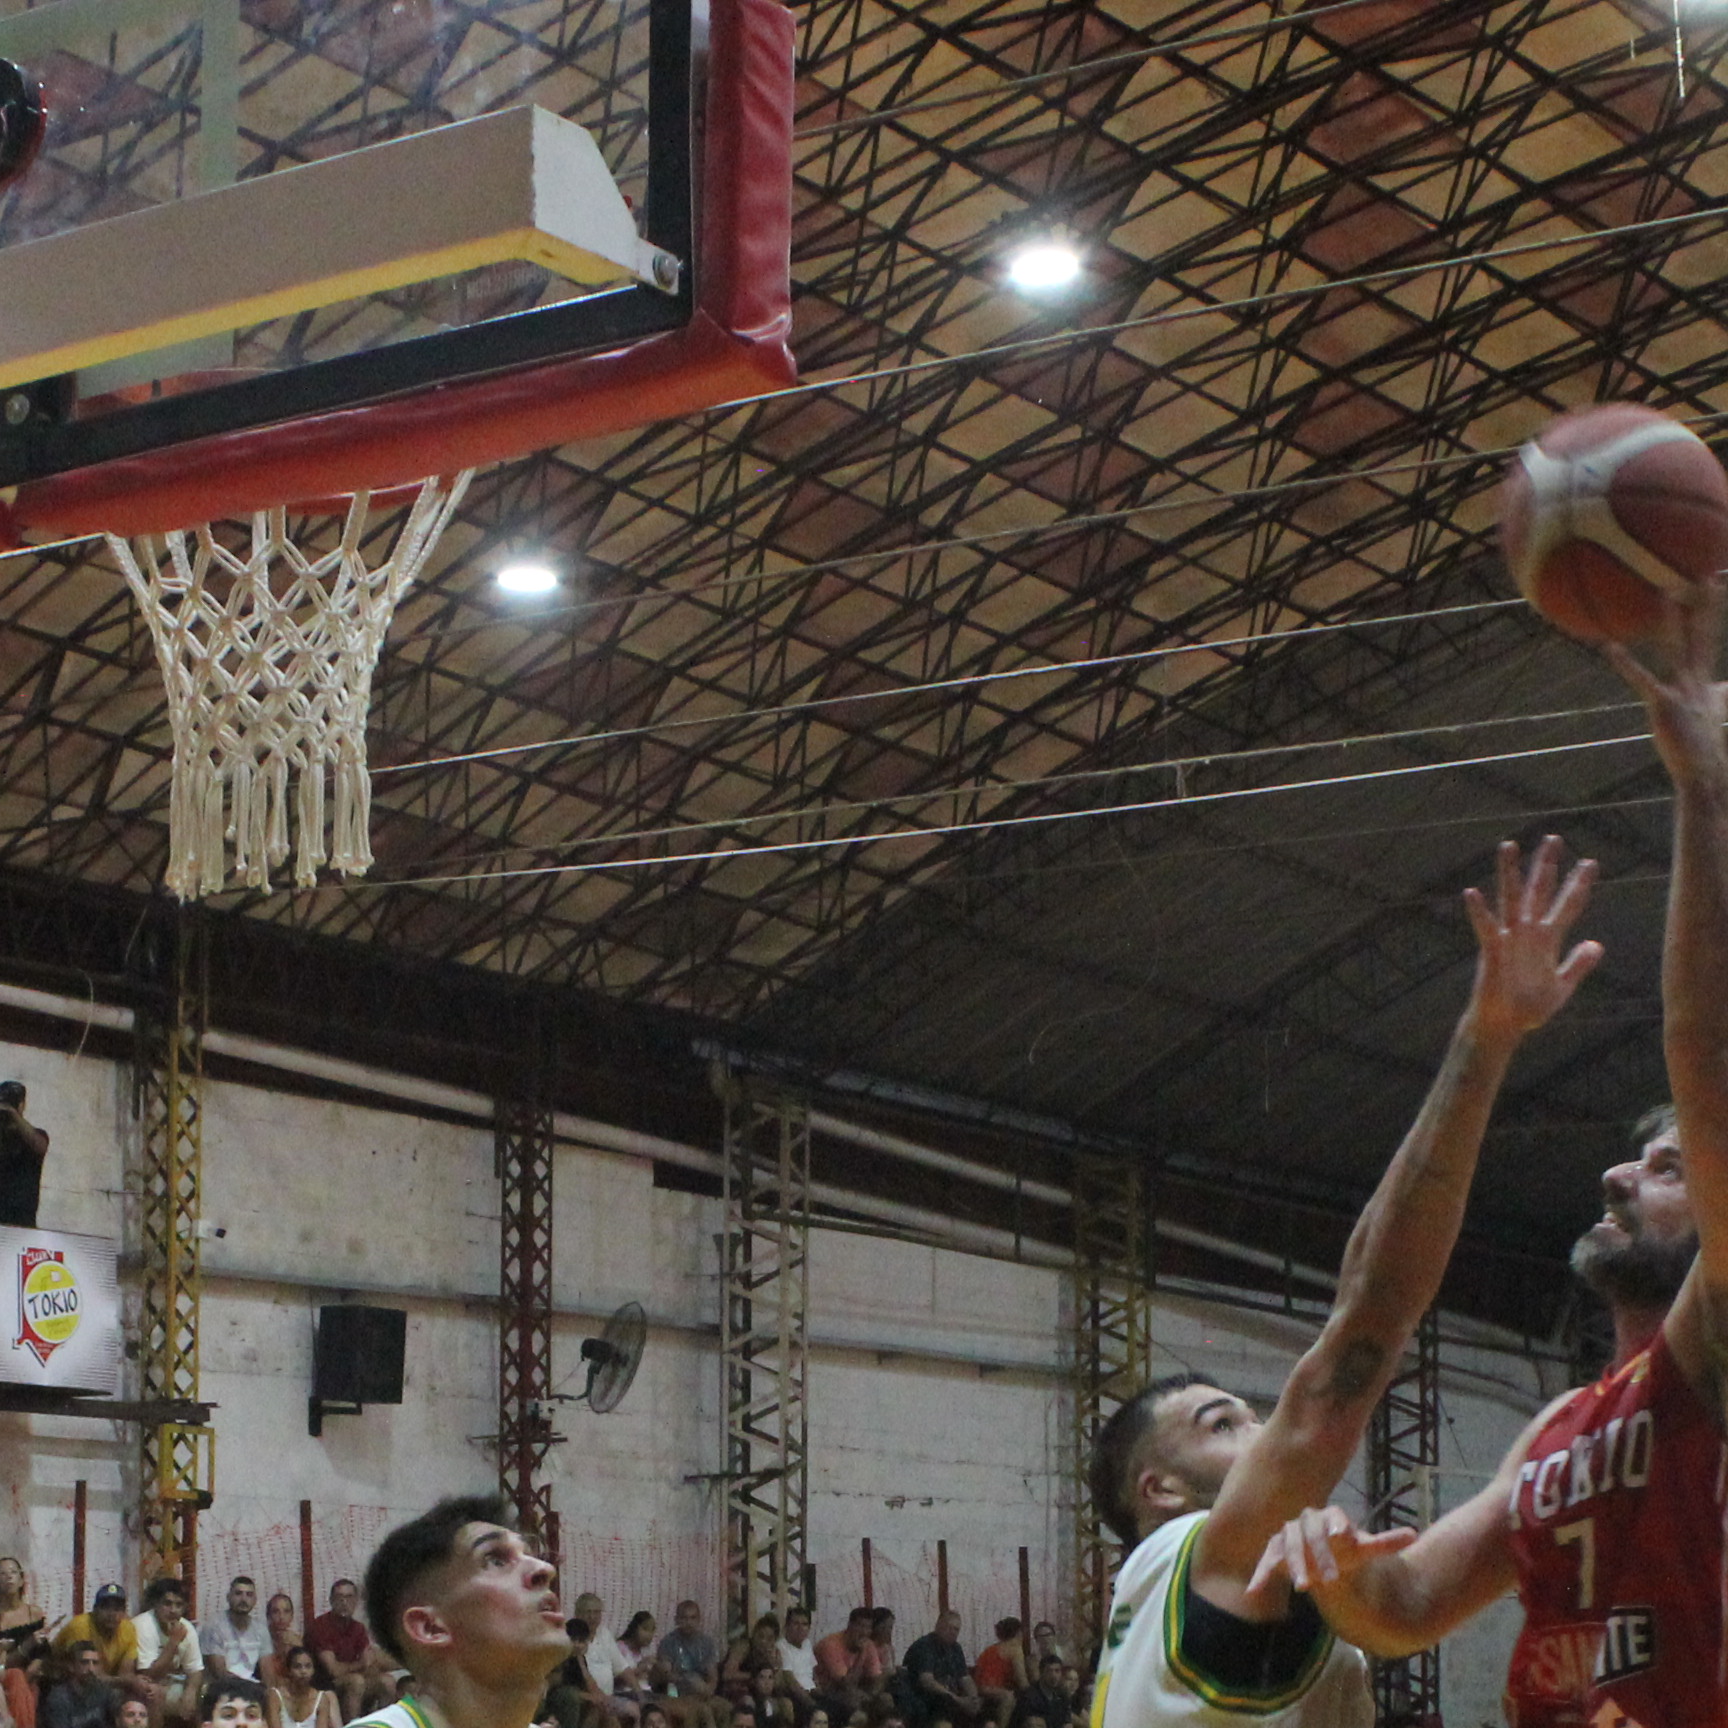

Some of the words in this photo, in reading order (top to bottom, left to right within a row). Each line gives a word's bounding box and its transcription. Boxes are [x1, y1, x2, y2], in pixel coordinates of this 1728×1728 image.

[28, 1287, 78, 1320] TOKIO
[1509, 1408, 1654, 1531] TOKIO
[1554, 1517, 1596, 1610] 7
